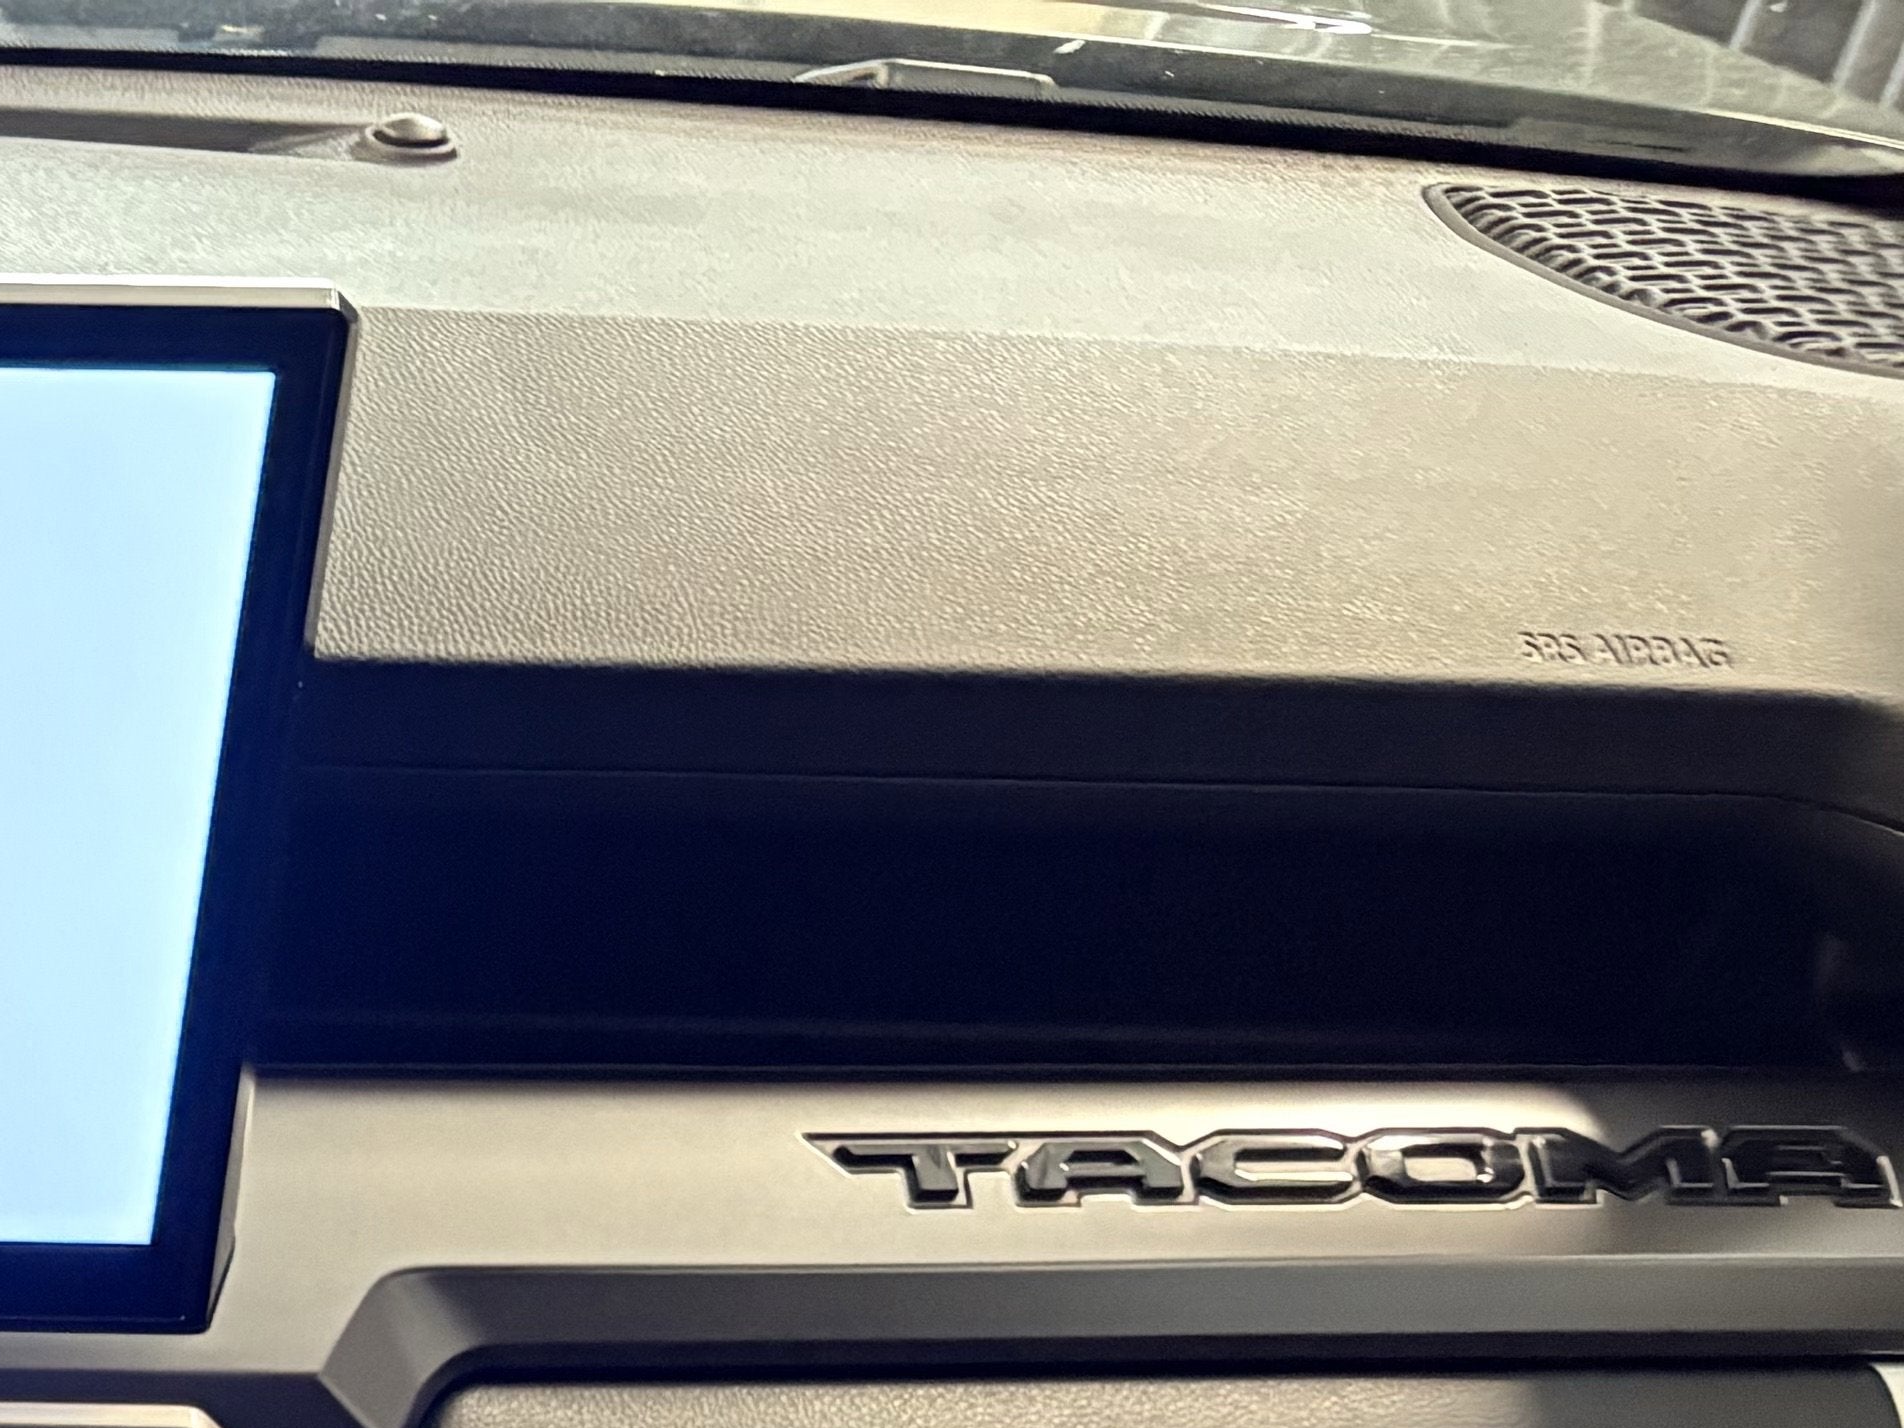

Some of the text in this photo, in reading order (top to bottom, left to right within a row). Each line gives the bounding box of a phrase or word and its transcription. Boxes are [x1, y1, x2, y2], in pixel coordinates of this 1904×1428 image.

[1517, 631, 1733, 668] SRS AIRBAG
[796, 1125, 1902, 1213] TACOMA
